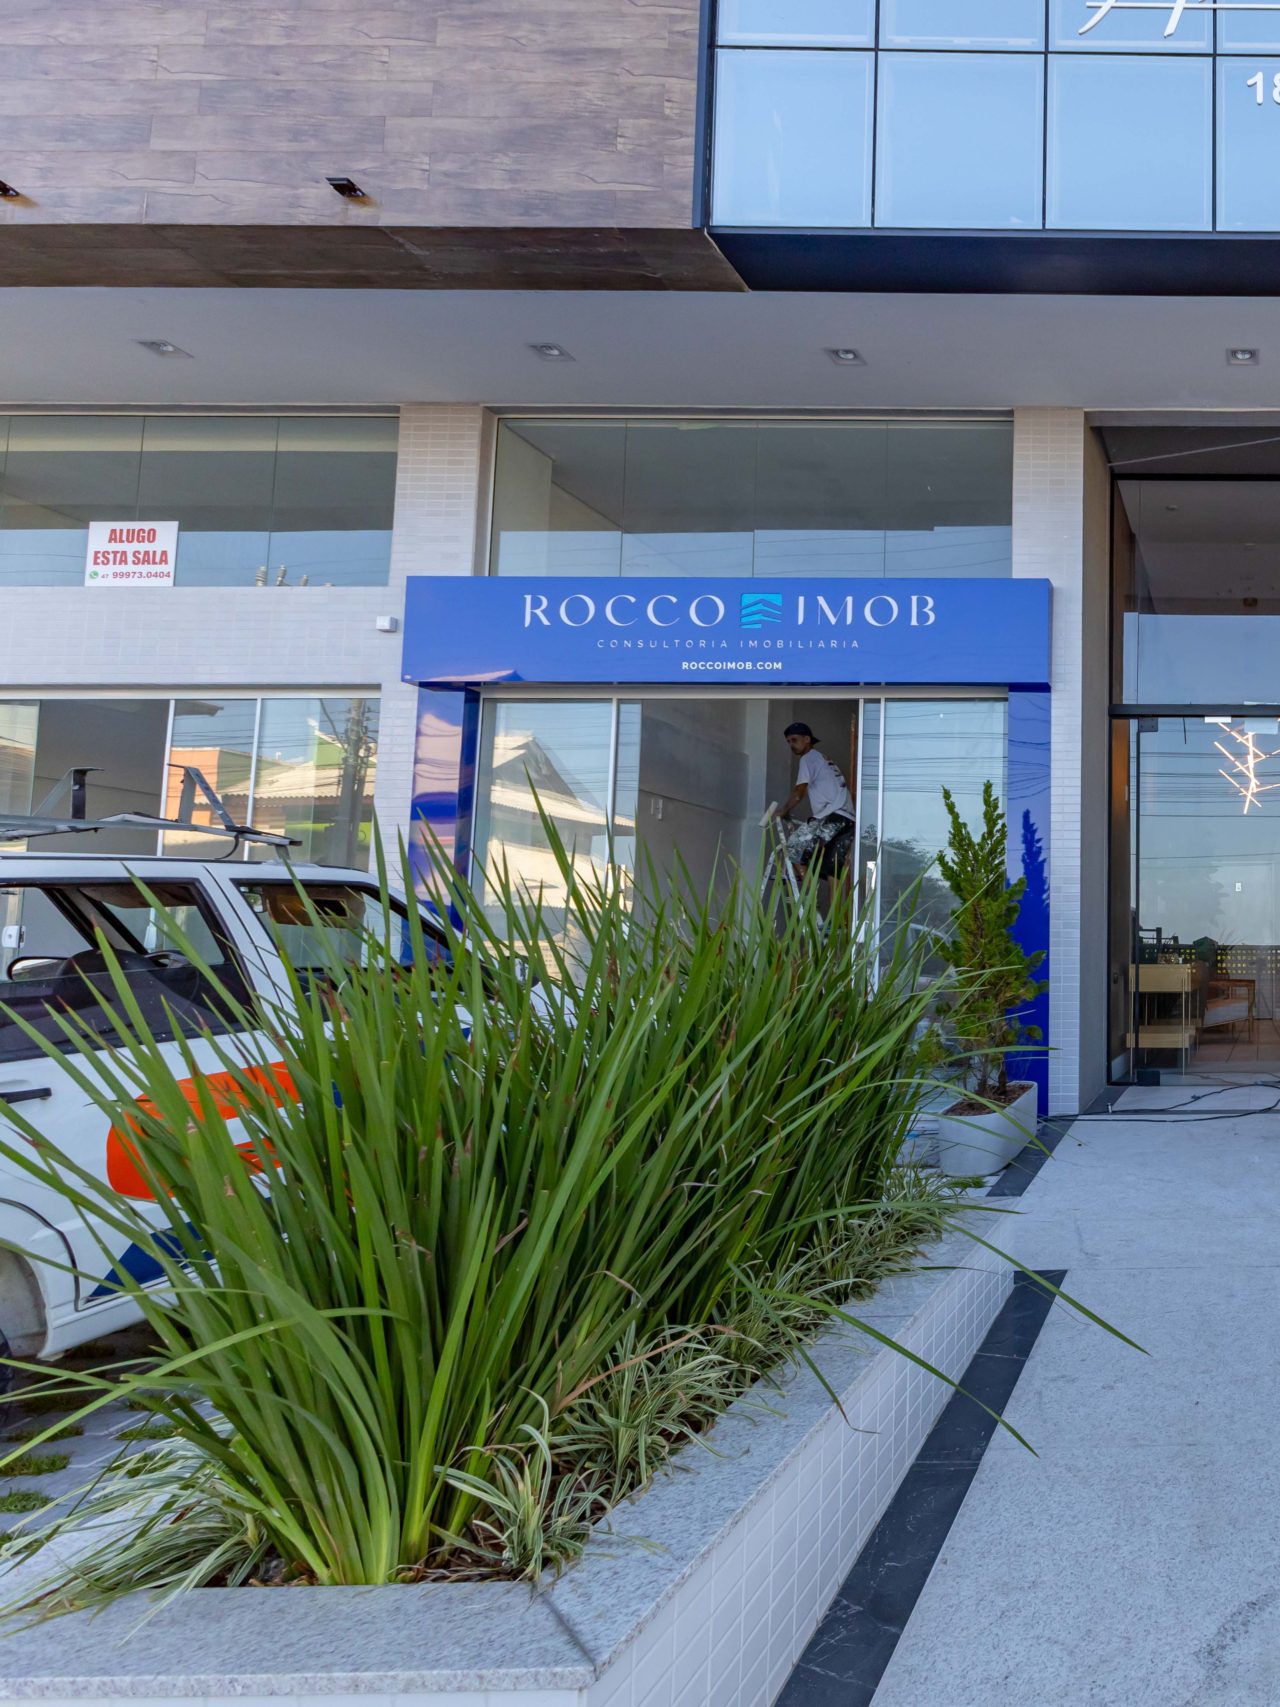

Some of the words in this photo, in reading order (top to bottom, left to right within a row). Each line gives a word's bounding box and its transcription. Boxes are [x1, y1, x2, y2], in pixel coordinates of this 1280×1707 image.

[108, 528, 157, 544] ALUGO
[92, 550, 128, 566] ESTA
[131, 550, 169, 566] SALA
[112, 571, 171, 579] 99973.0404
[524, 594, 726, 628] ROCCO
[797, 595, 936, 627] IMOB
[597, 639, 728, 648] CONSULTORIA
[740, 639, 860, 649] IMOBILIARIA
[681, 661, 783, 670] ROCCOIMOB.COM
